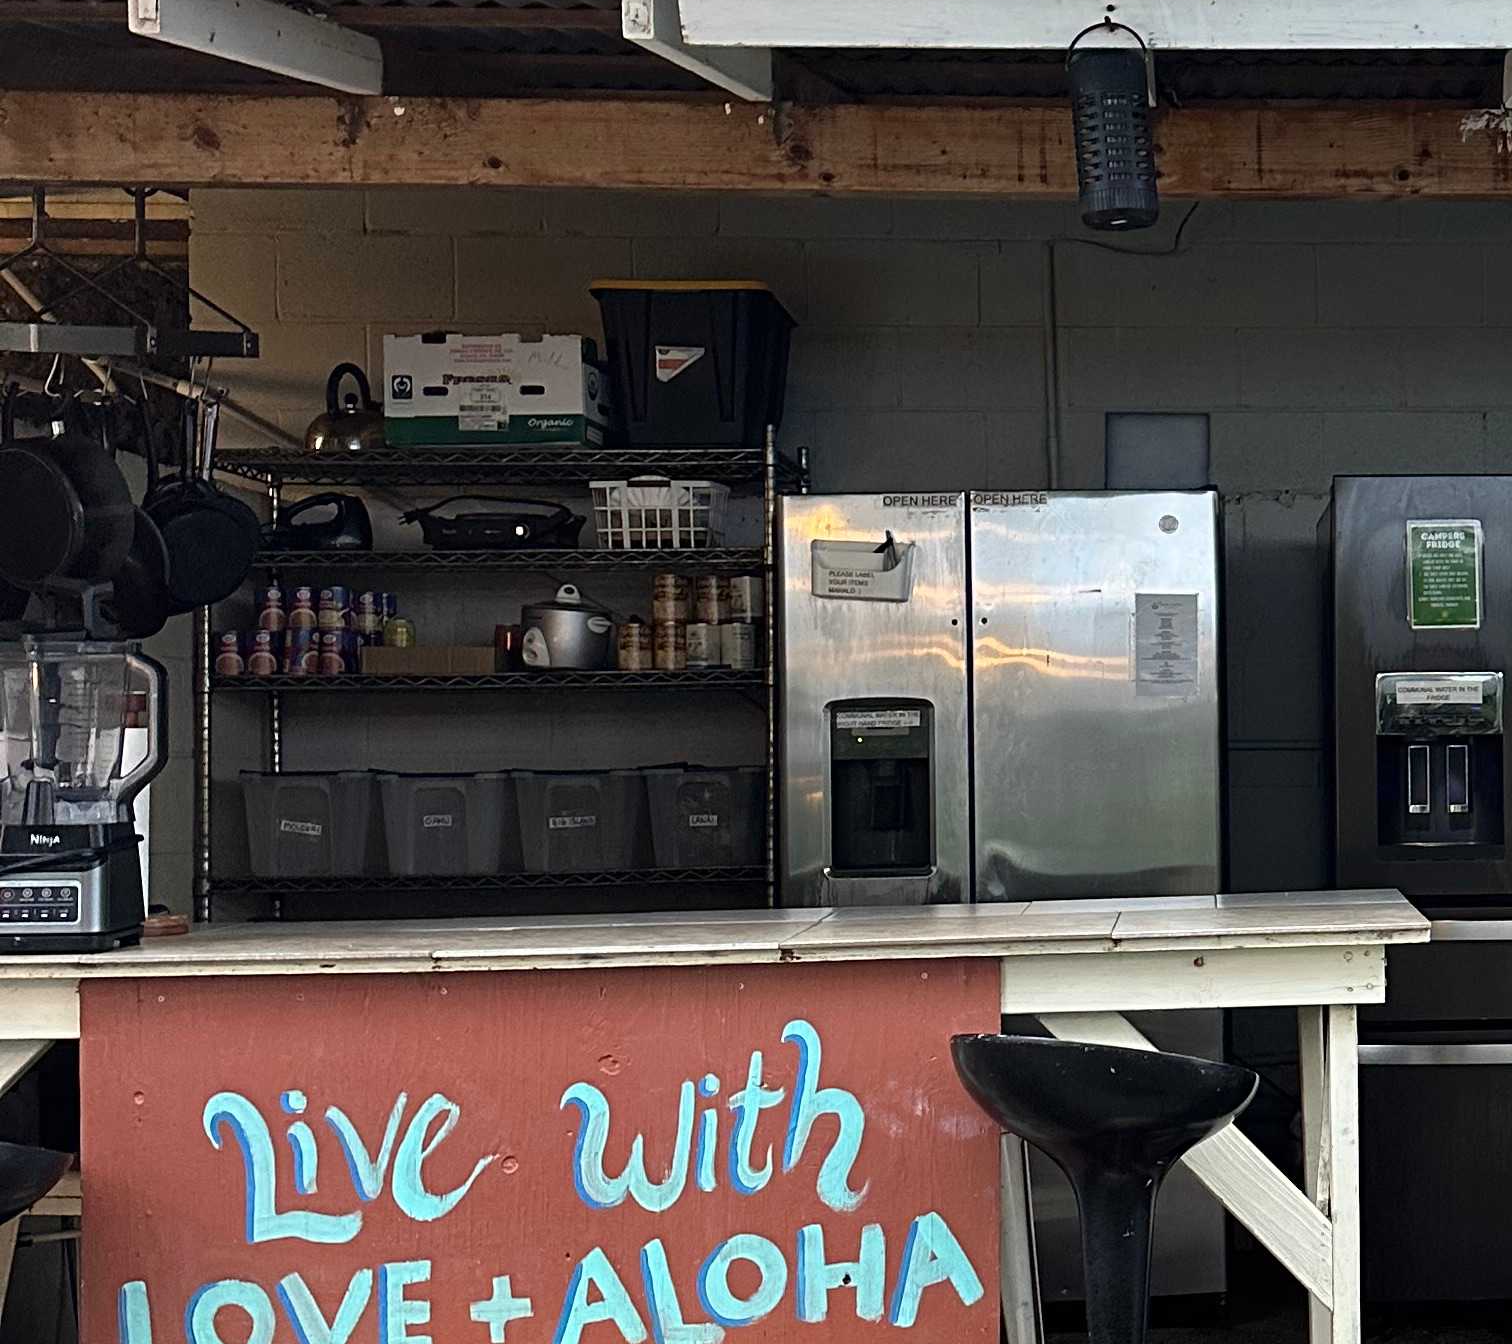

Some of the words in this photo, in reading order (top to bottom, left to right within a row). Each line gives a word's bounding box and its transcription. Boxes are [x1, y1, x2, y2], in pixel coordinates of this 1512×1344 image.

[883, 494, 919, 506] OPEN
[921, 494, 957, 506] HERE
[974, 493, 1010, 505] OPEN
[1011, 493, 1048, 505] HERE
[1421, 531, 1466, 541] CAMPERS
[202, 1089, 498, 1245] Live
[469, 1274, 534, 1344] +
